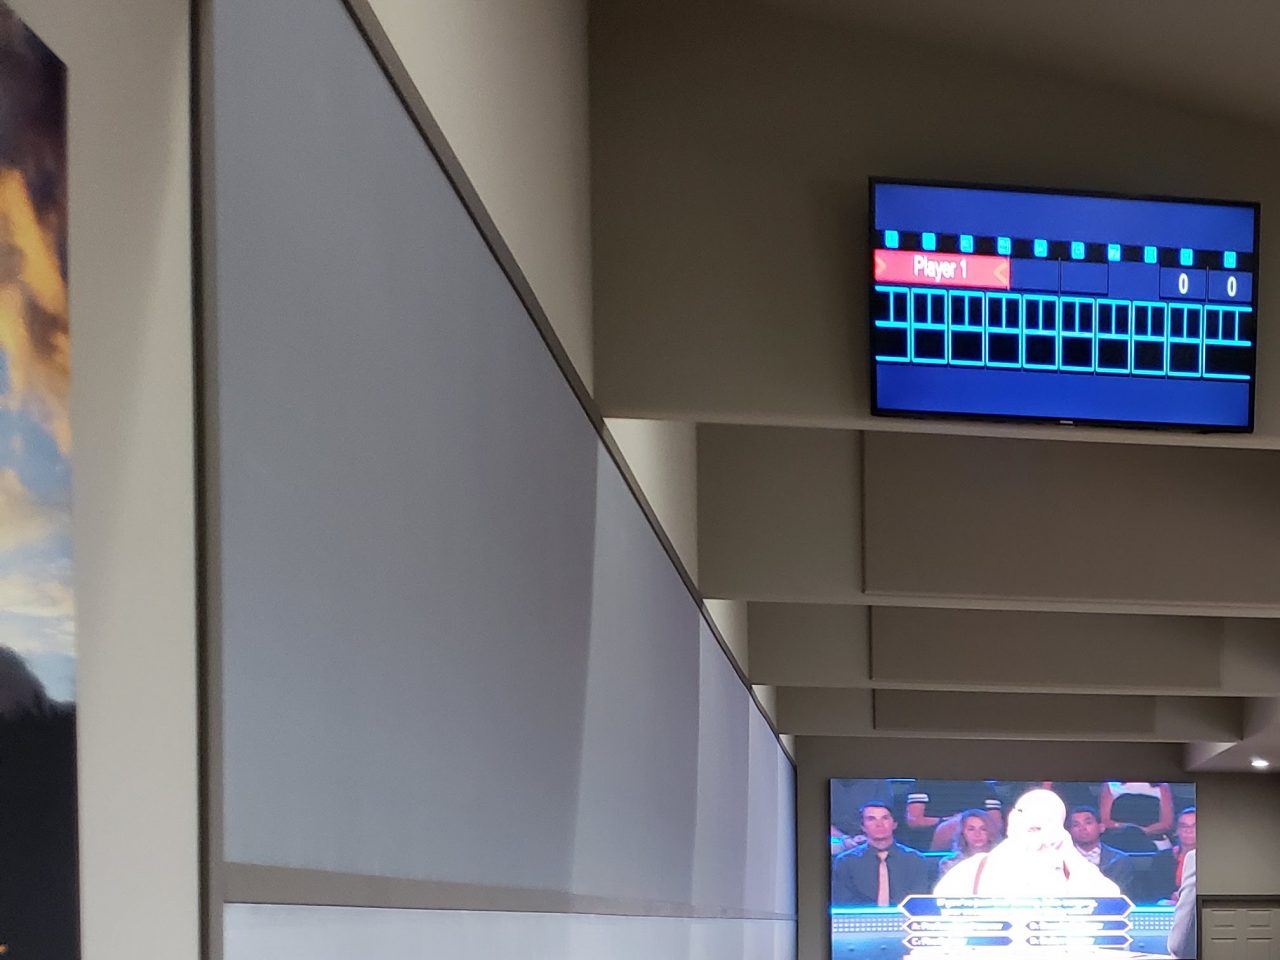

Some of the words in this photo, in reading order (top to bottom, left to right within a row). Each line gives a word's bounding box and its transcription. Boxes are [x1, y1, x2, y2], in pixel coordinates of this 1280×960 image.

[913, 255, 956, 283] Player
[960, 258, 967, 279] 1
[1178, 272, 1188, 295] 0
[1227, 275, 1237, 297] 0
